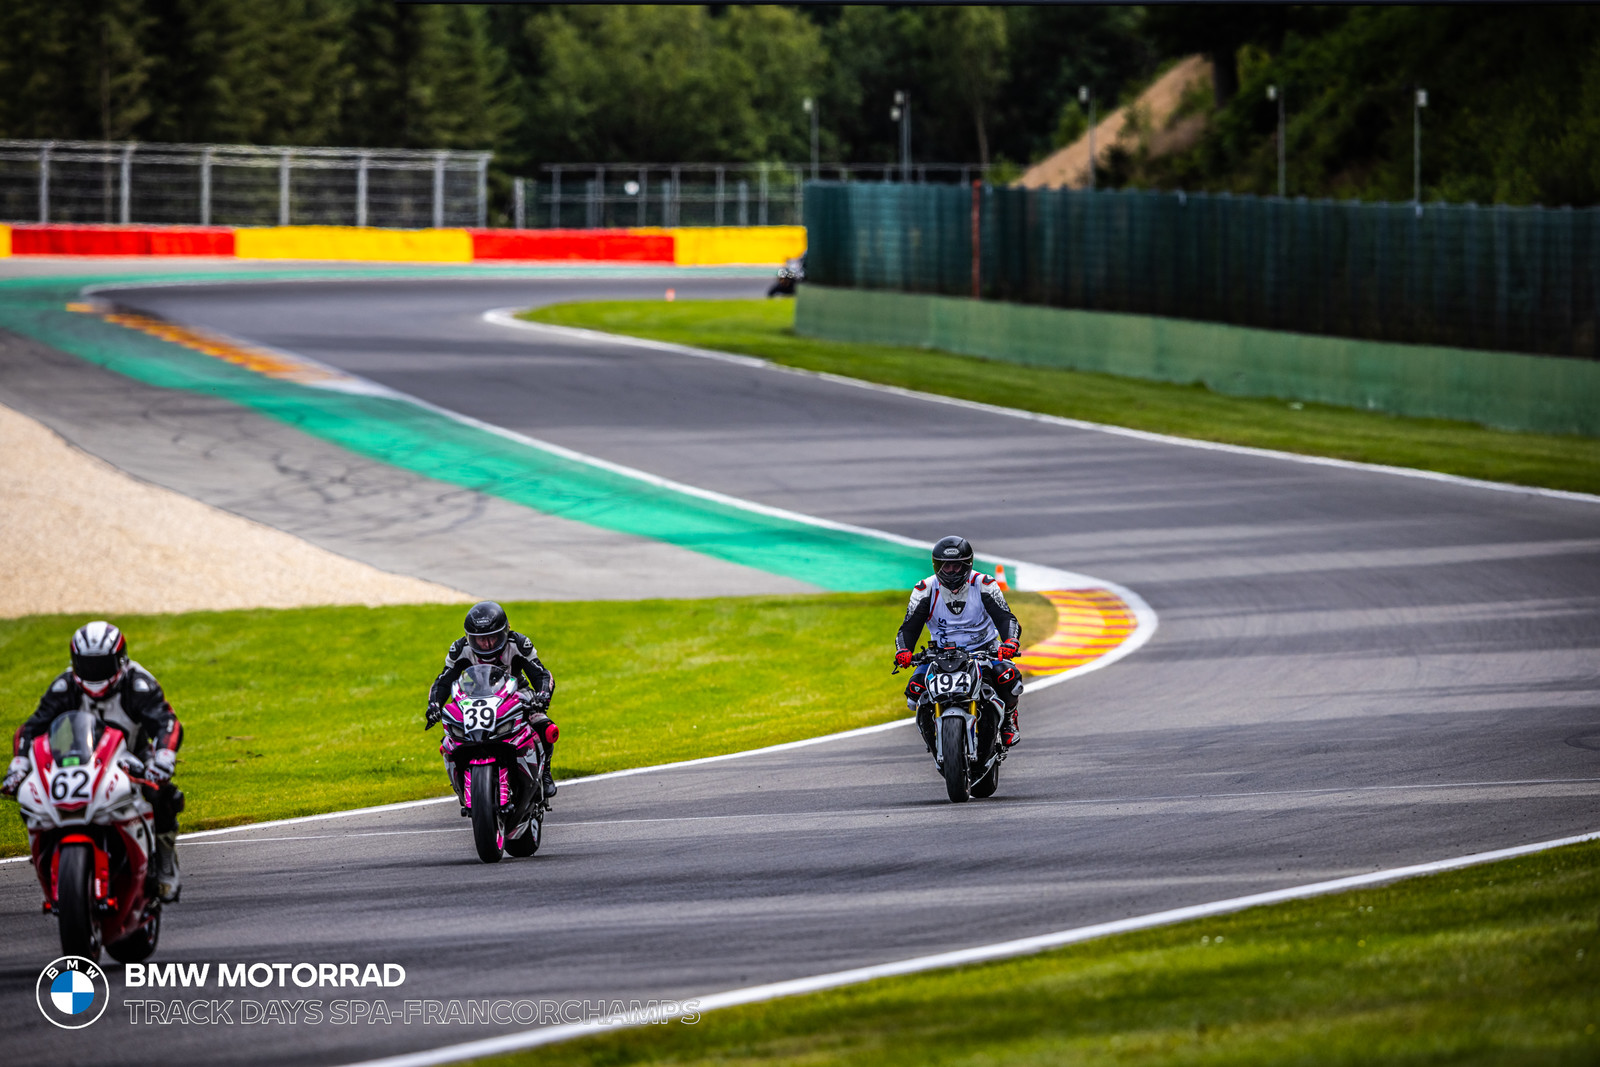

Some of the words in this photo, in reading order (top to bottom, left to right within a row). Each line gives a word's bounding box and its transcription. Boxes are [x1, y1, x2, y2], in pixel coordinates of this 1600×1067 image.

[930, 673, 969, 695] 194
[465, 707, 495, 730] 39
[51, 769, 90, 800] 62
